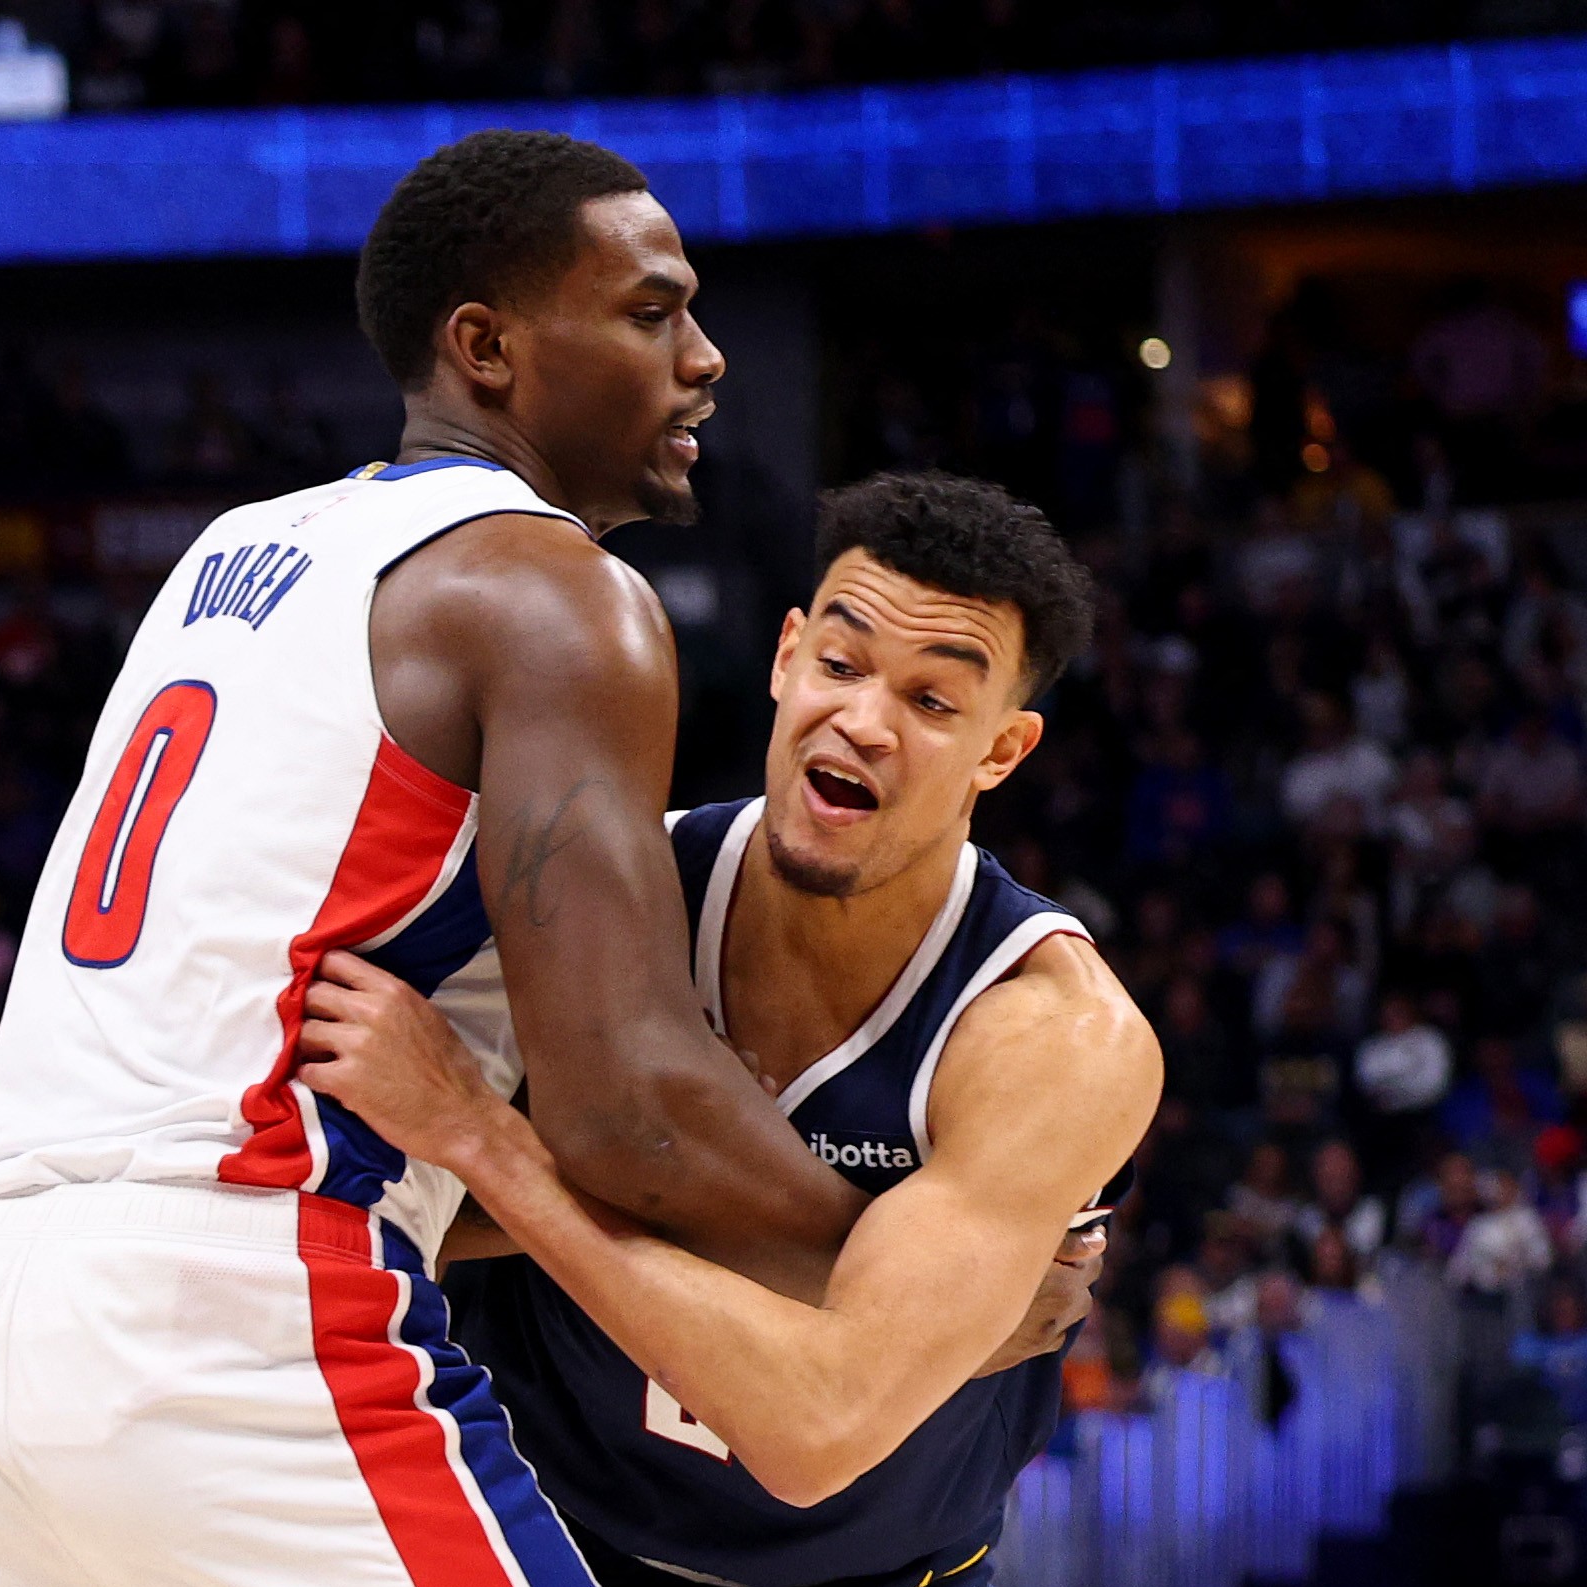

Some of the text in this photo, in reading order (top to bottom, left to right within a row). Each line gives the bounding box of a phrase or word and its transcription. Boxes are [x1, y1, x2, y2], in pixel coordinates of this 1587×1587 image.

[182, 543, 313, 632] DUREN
[62, 679, 218, 970] 0
[810, 1132, 914, 1169] ibotta
